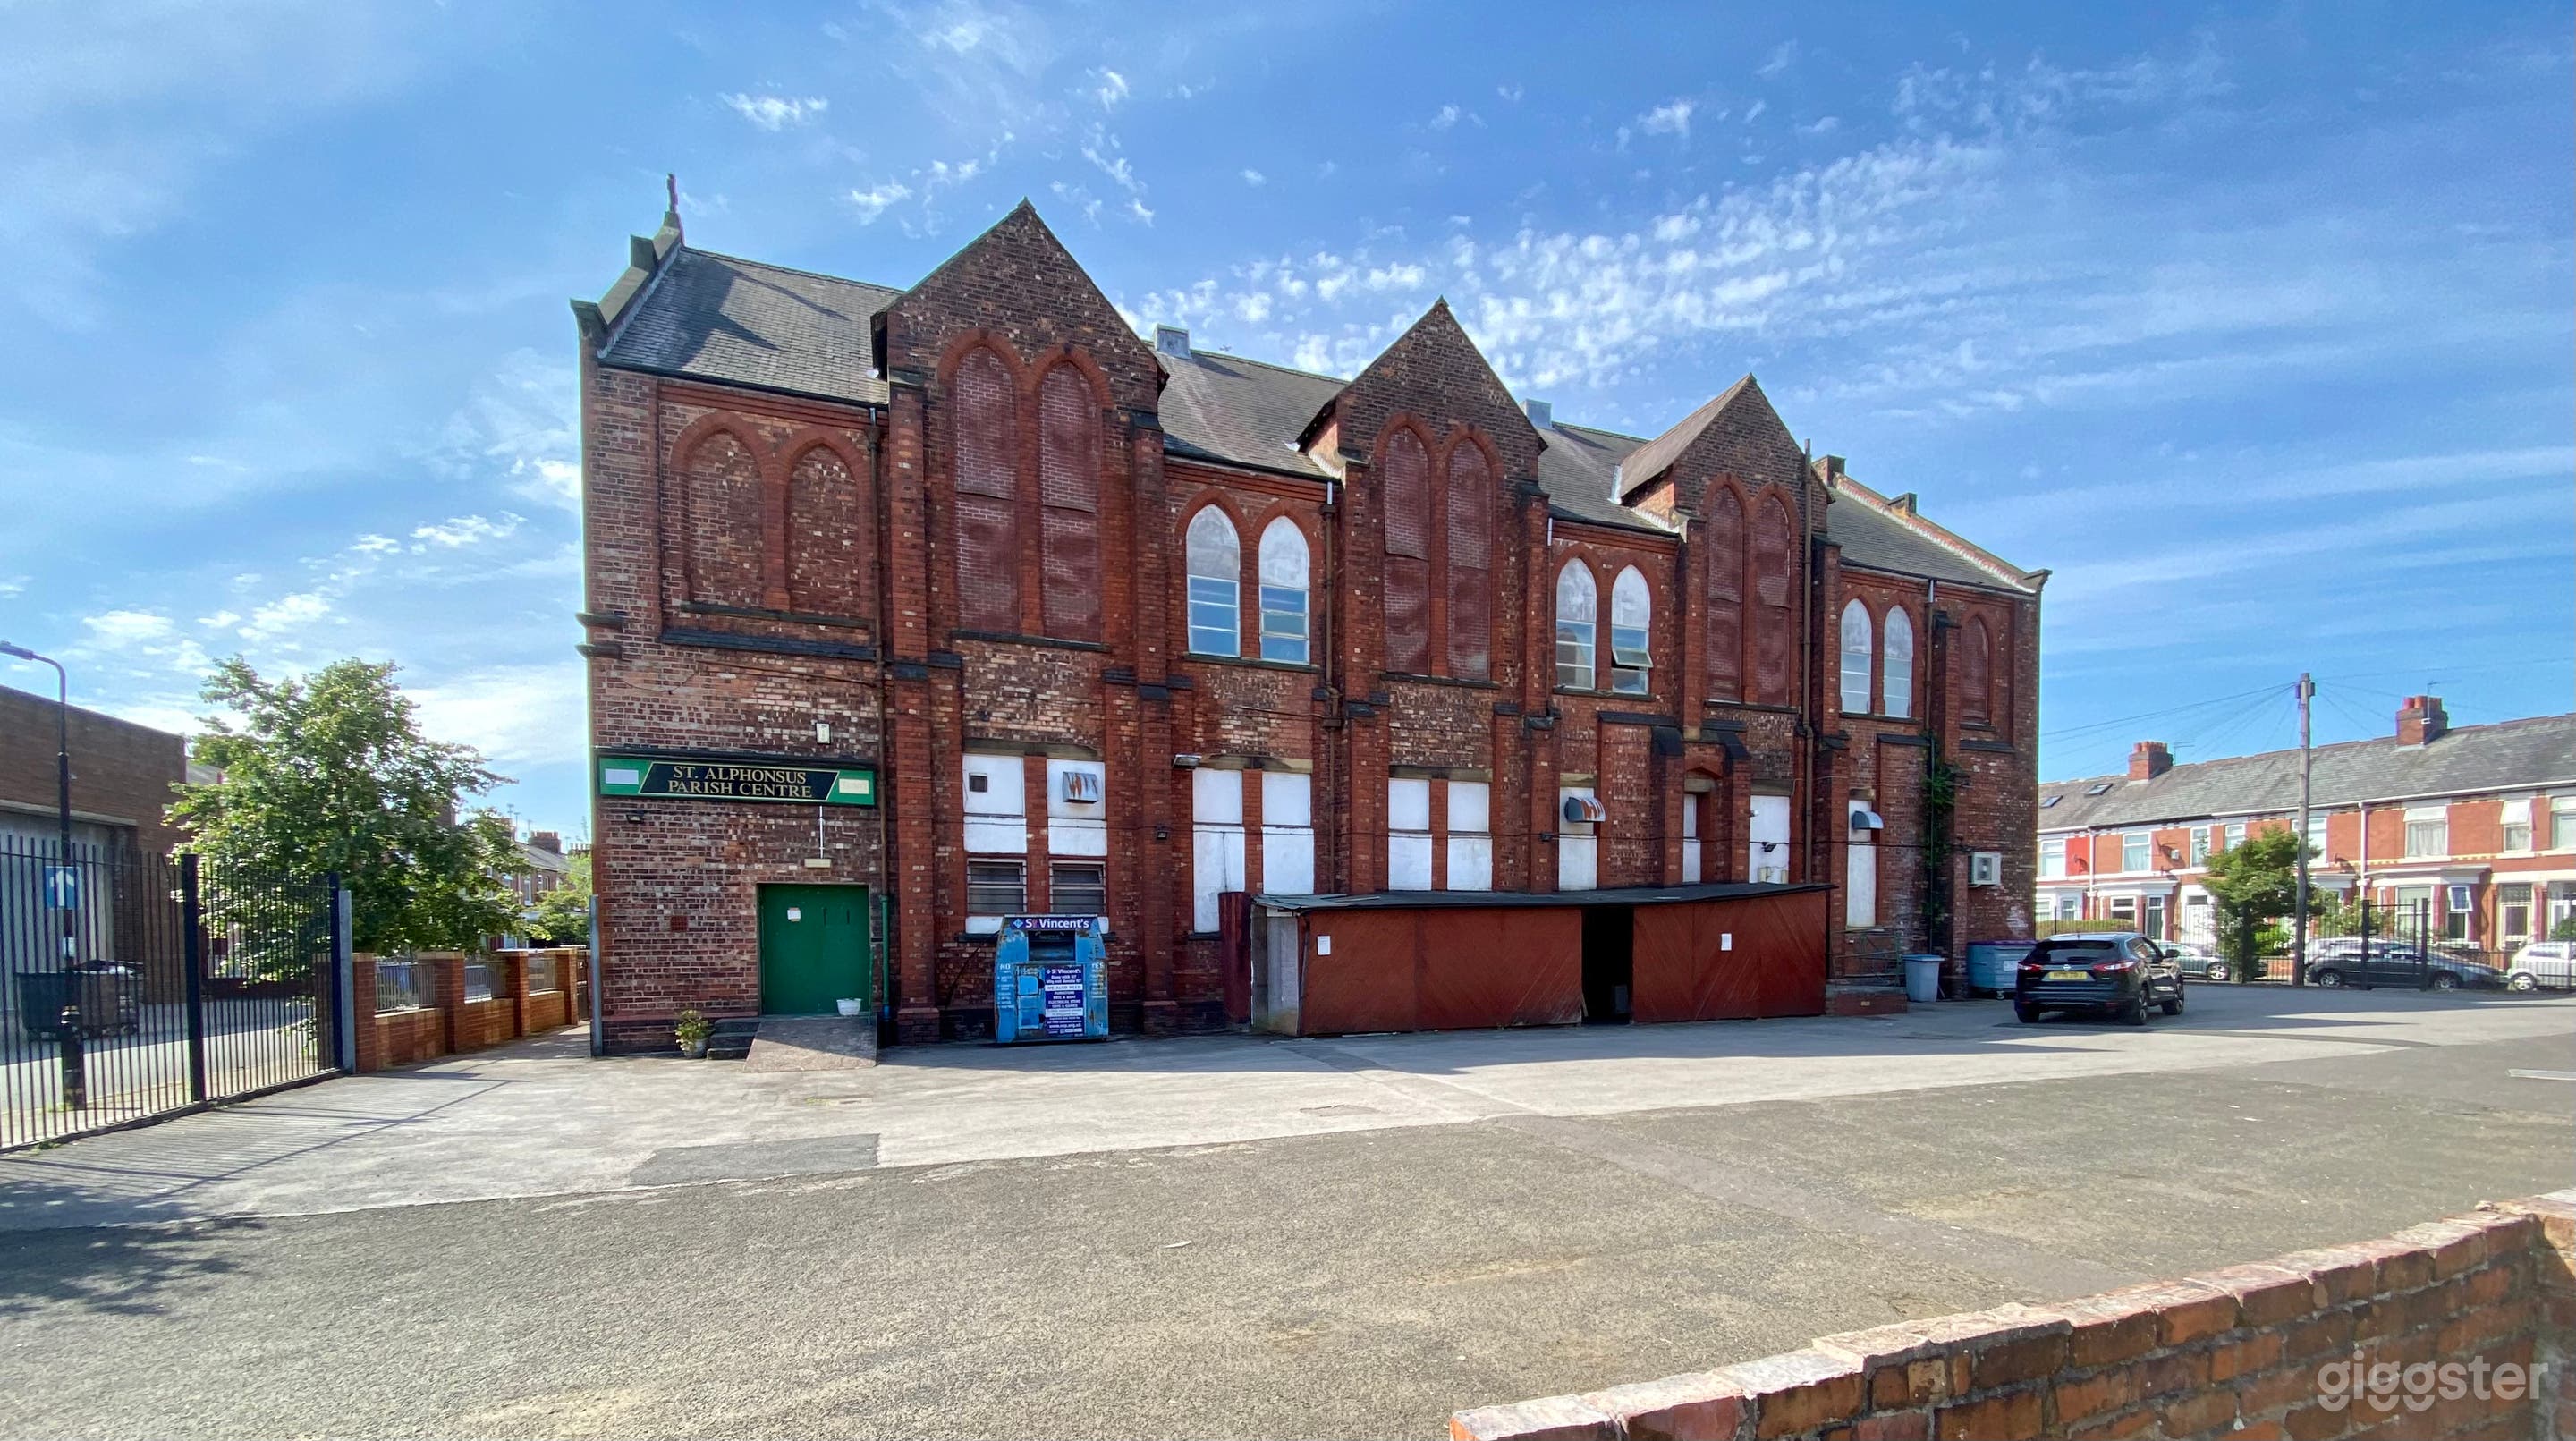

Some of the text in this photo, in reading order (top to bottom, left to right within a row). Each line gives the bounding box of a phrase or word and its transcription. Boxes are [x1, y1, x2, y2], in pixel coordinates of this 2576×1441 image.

[673, 766, 807, 784] ST. ALPHONSUS
[668, 780, 812, 798] PARISH CENTRE
[1039, 918, 1089, 928] Vincent's
